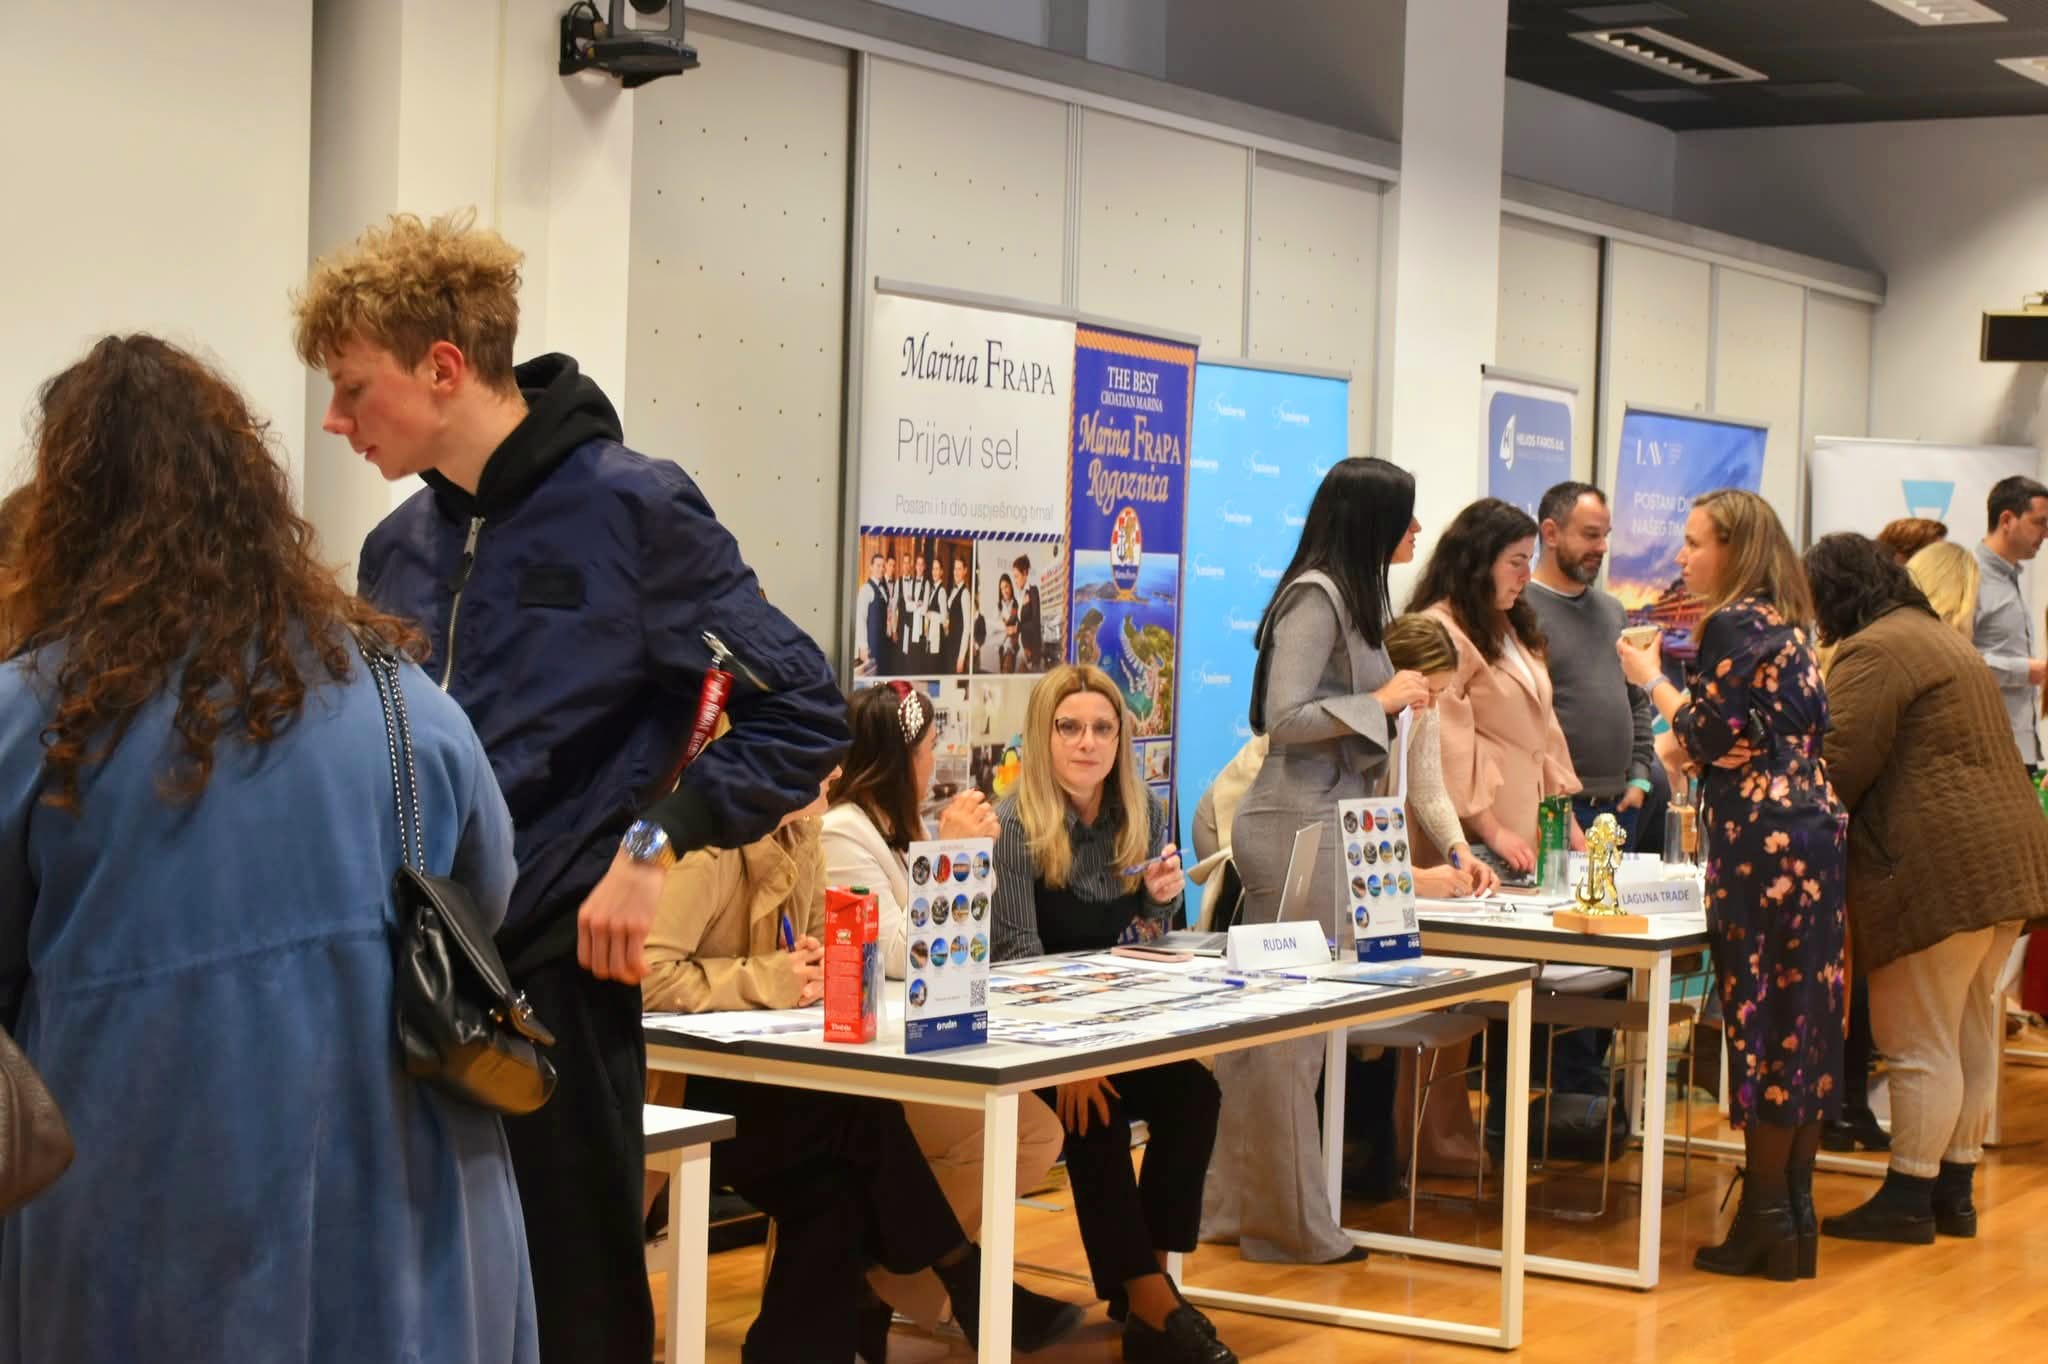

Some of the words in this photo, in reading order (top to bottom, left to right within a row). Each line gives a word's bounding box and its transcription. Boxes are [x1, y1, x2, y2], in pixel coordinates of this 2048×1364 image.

[901, 331, 979, 385] Marina
[984, 338, 1056, 396] FRAPA
[1107, 366, 1131, 391] THE
[1133, 369, 1159, 396] BEST
[1101, 390, 1136, 410] CROATIAN
[1136, 395, 1163, 413] MARINA
[897, 417, 972, 476] Prijavi
[981, 428, 1019, 471] se!
[1078, 410, 1131, 458] Marina
[1133, 414, 1181, 465] FRAPA
[1086, 458, 1169, 515] Rogoznica
[895, 494, 933, 515] Postani
[949, 498, 969, 517] dio
[970, 501, 1028, 523] uspješnog
[1632, 491, 1676, 513] POSTANI
[1621, 891, 1660, 905] LAGUNA
[1660, 888, 1689, 903] TRADE
[1263, 936, 1297, 951] RUDAN
